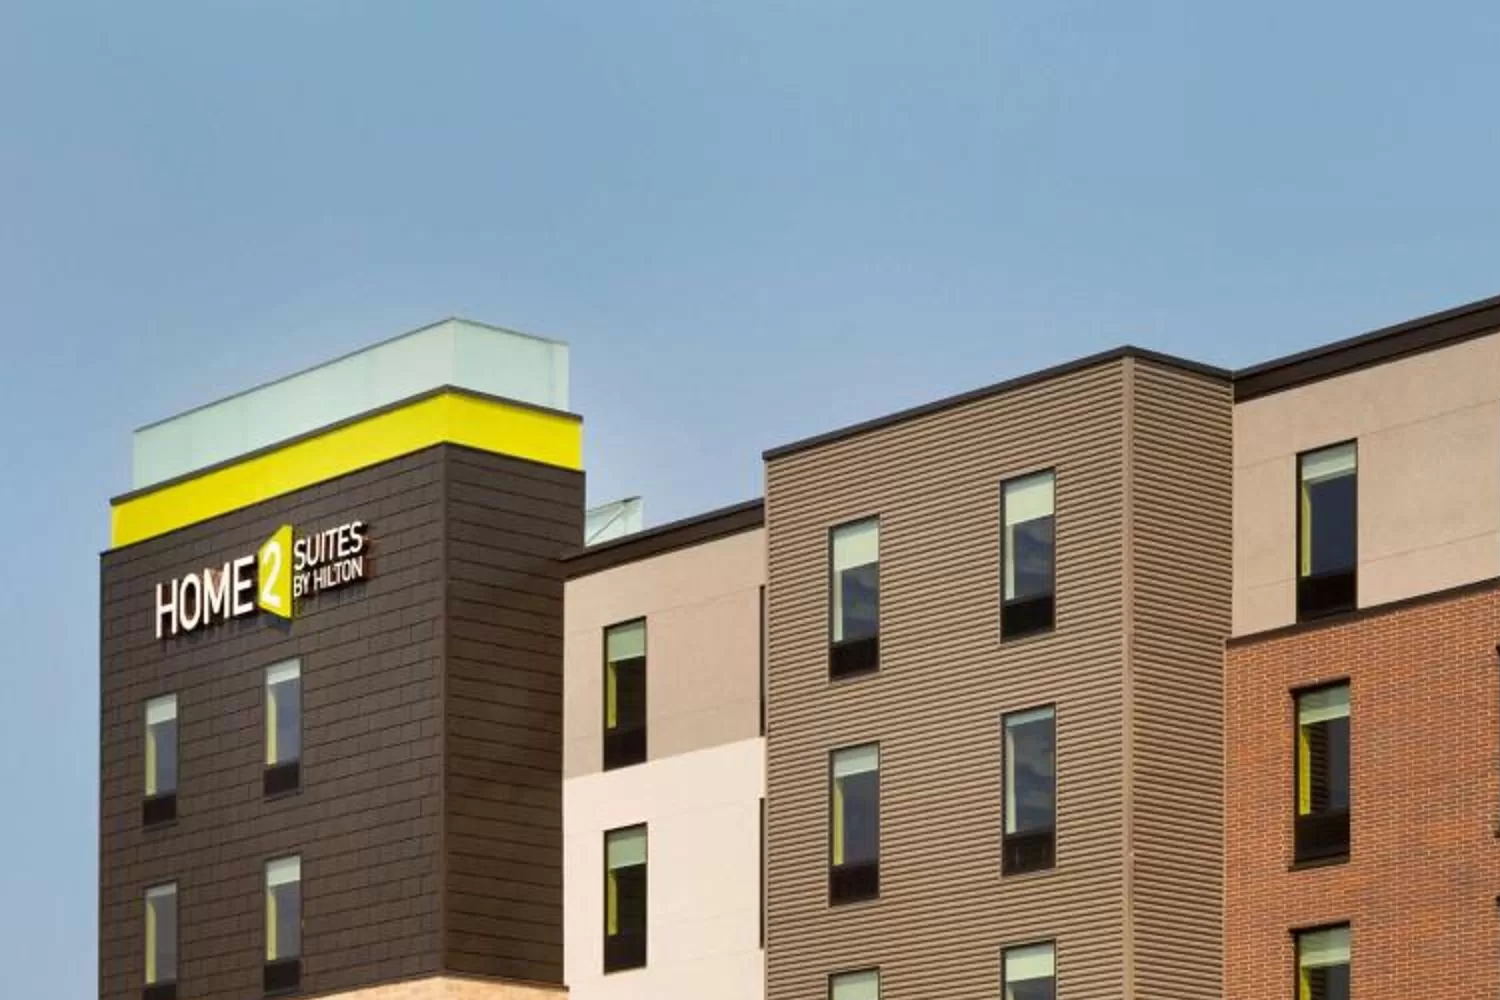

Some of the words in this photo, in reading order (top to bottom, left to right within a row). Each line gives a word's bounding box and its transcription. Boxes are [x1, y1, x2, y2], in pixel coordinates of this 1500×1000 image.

[155, 555, 254, 638] HOME
[262, 540, 282, 608] 2
[294, 521, 363, 571] SUITES
[294, 574, 312, 597] BY
[314, 556, 363, 590] HILTON
